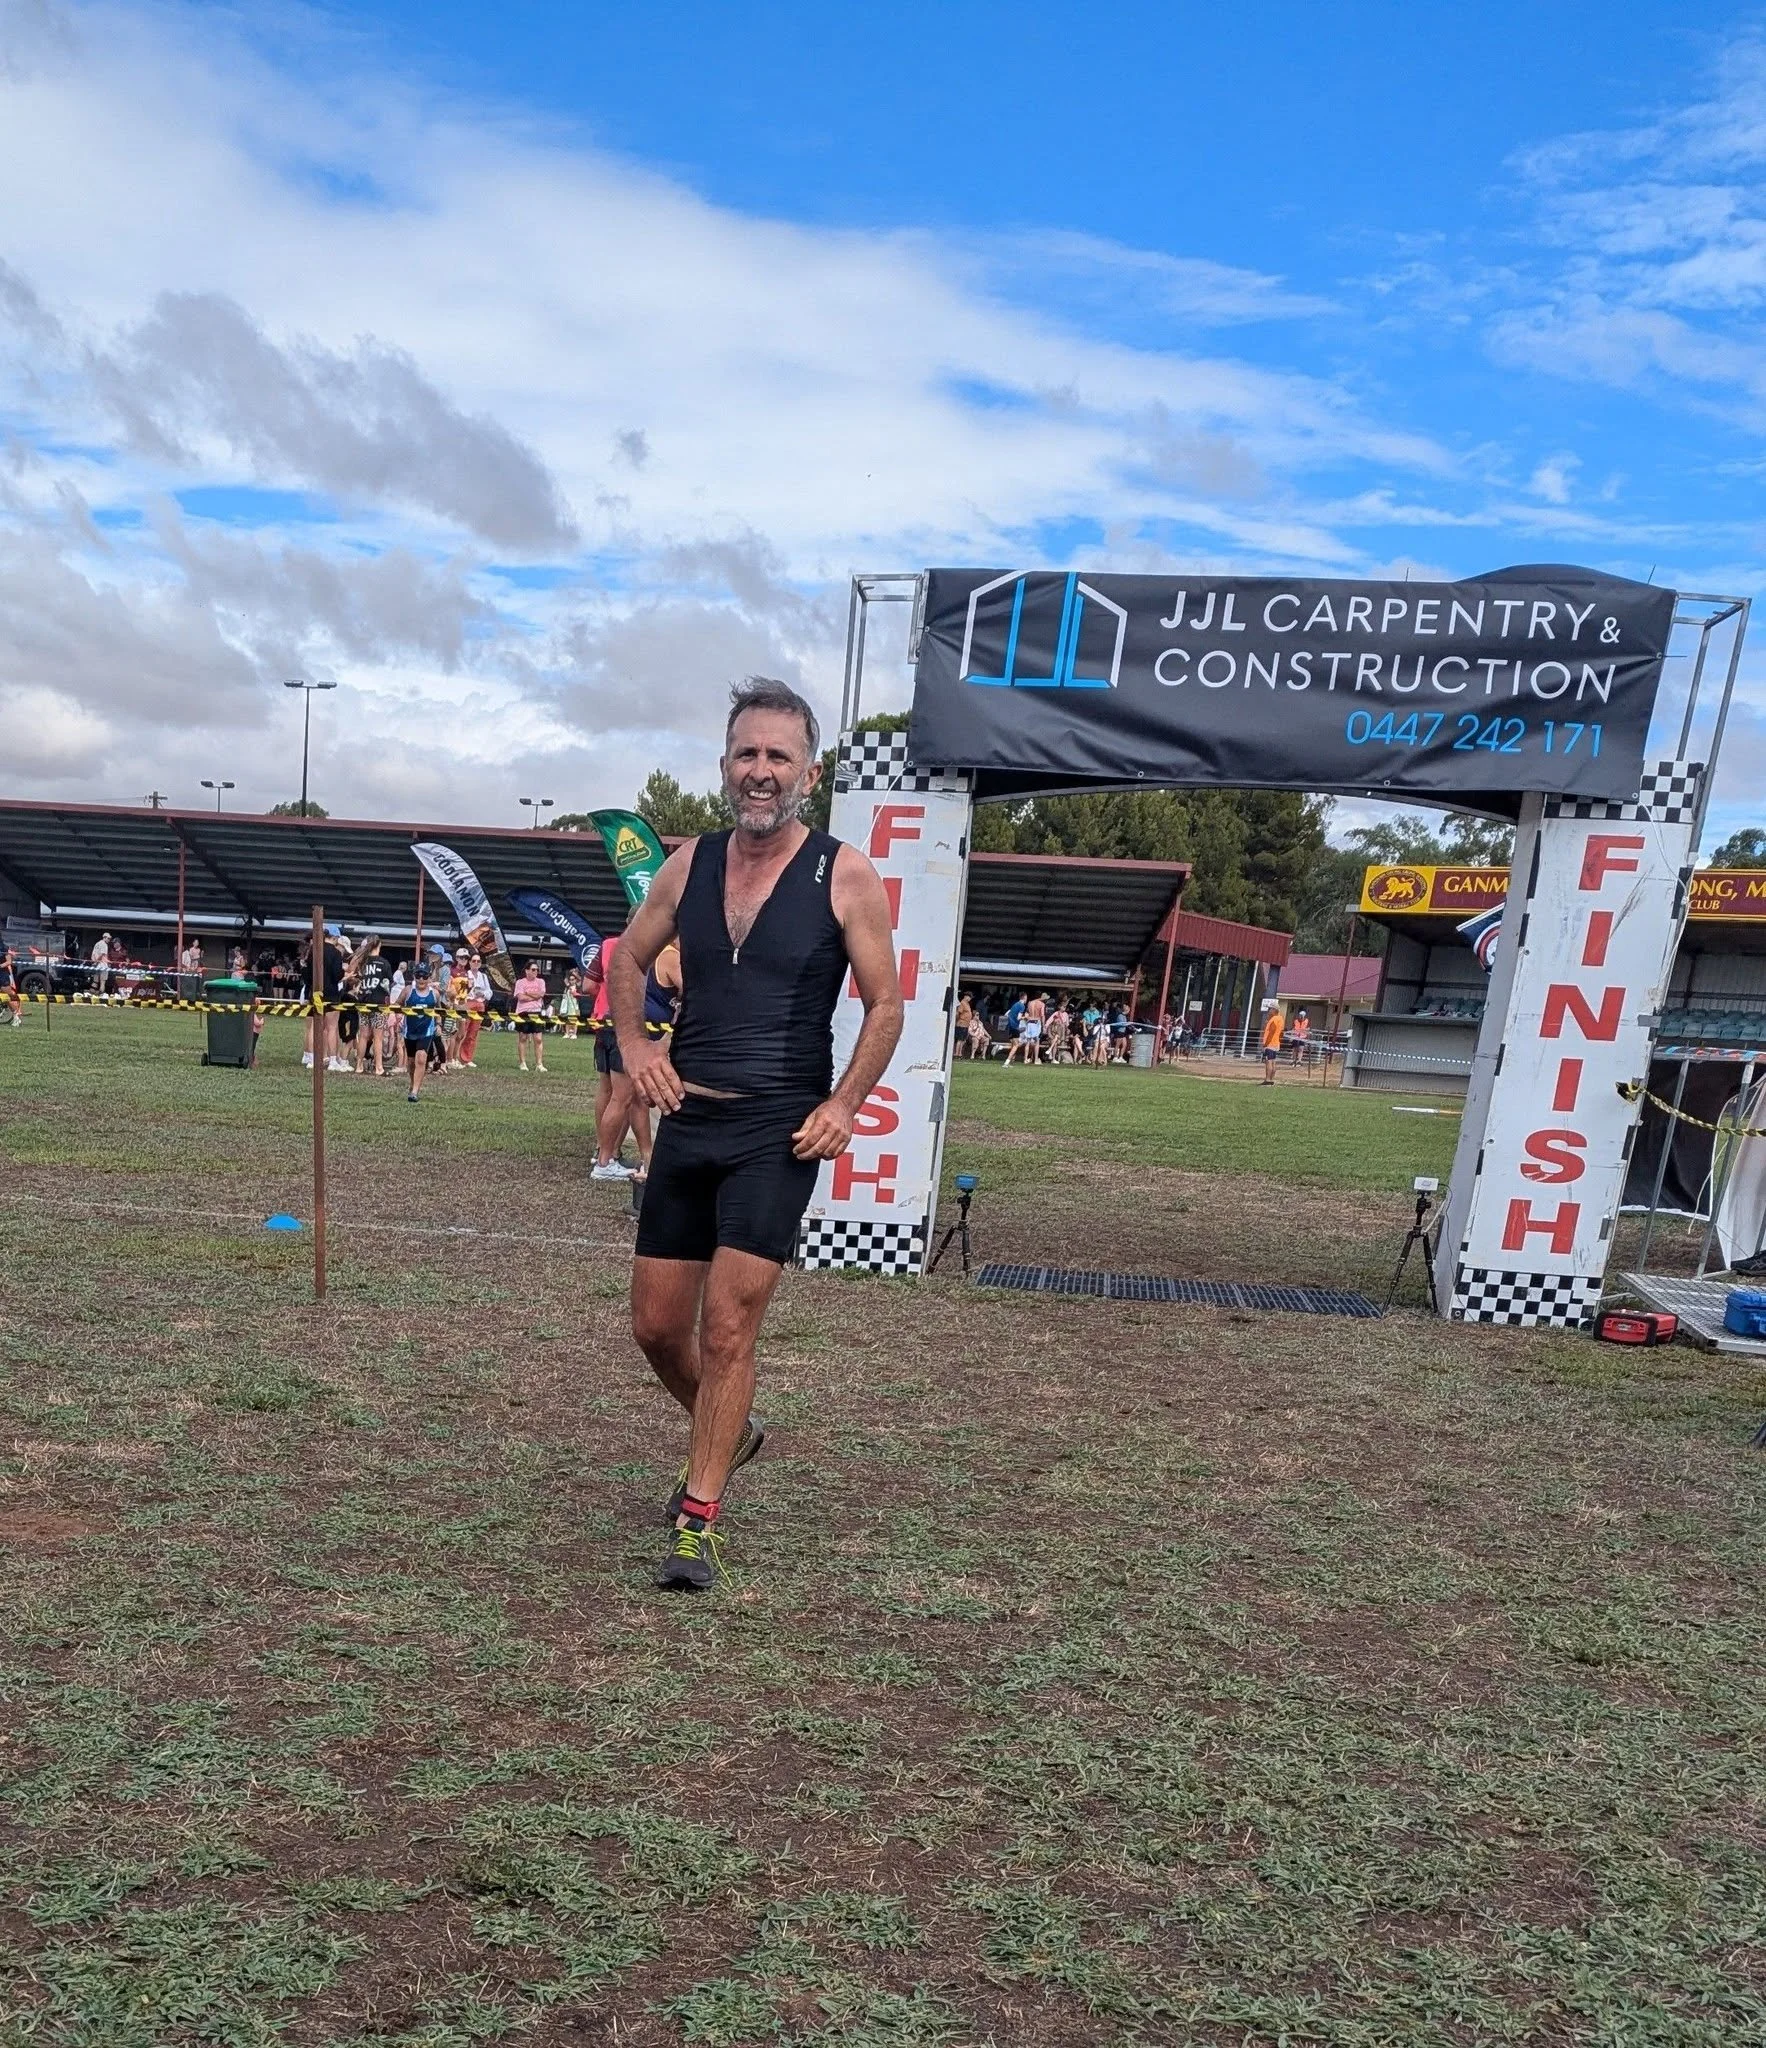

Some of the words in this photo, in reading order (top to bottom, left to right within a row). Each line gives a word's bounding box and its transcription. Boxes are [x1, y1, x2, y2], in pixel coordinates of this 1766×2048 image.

[1159, 590, 1247, 632] JJL
[1263, 593, 1597, 643] CARPENTRY
[1600, 616, 1621, 644] &
[1154, 647, 1617, 704] CONSTRUCTION
[1345, 709, 1446, 747] 0447
[1453, 713, 1527, 753] 242
[1543, 720, 1604, 758] 171
[618, 837, 638, 853] CRT
[539, 901, 587, 946] GrainCorp
[1500, 834, 1645, 1255] FINISH
